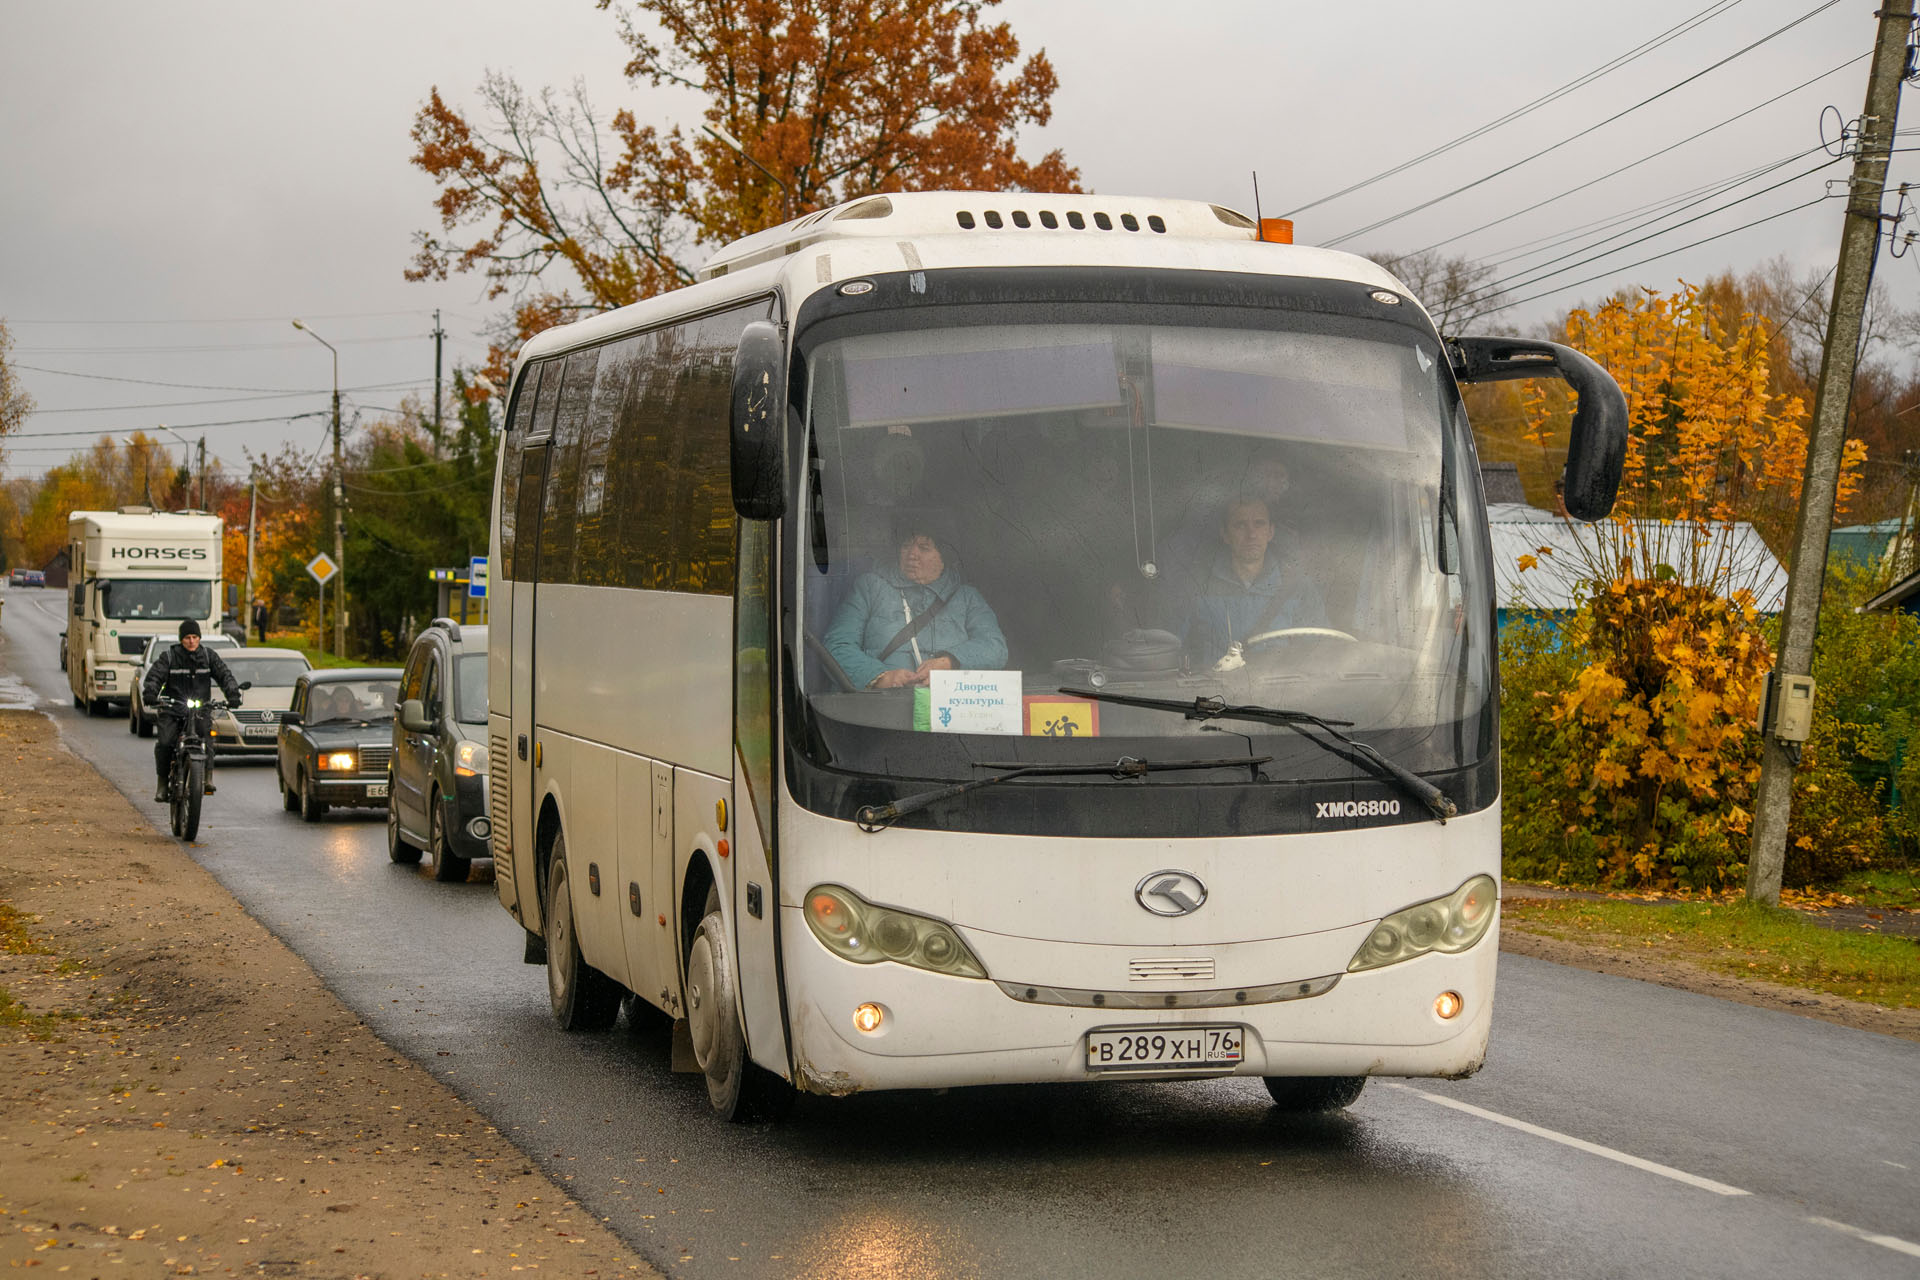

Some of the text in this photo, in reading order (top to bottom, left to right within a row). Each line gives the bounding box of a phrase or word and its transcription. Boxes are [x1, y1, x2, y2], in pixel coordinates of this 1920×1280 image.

[112, 547, 207, 560] HORSES
[953, 681, 998, 693] Дворец
[949, 697, 1004, 707] культуры
[1315, 799, 1400, 818] XMQ6800
[1209, 1032, 1234, 1051] 76
[1207, 1051, 1226, 1059] RUS
